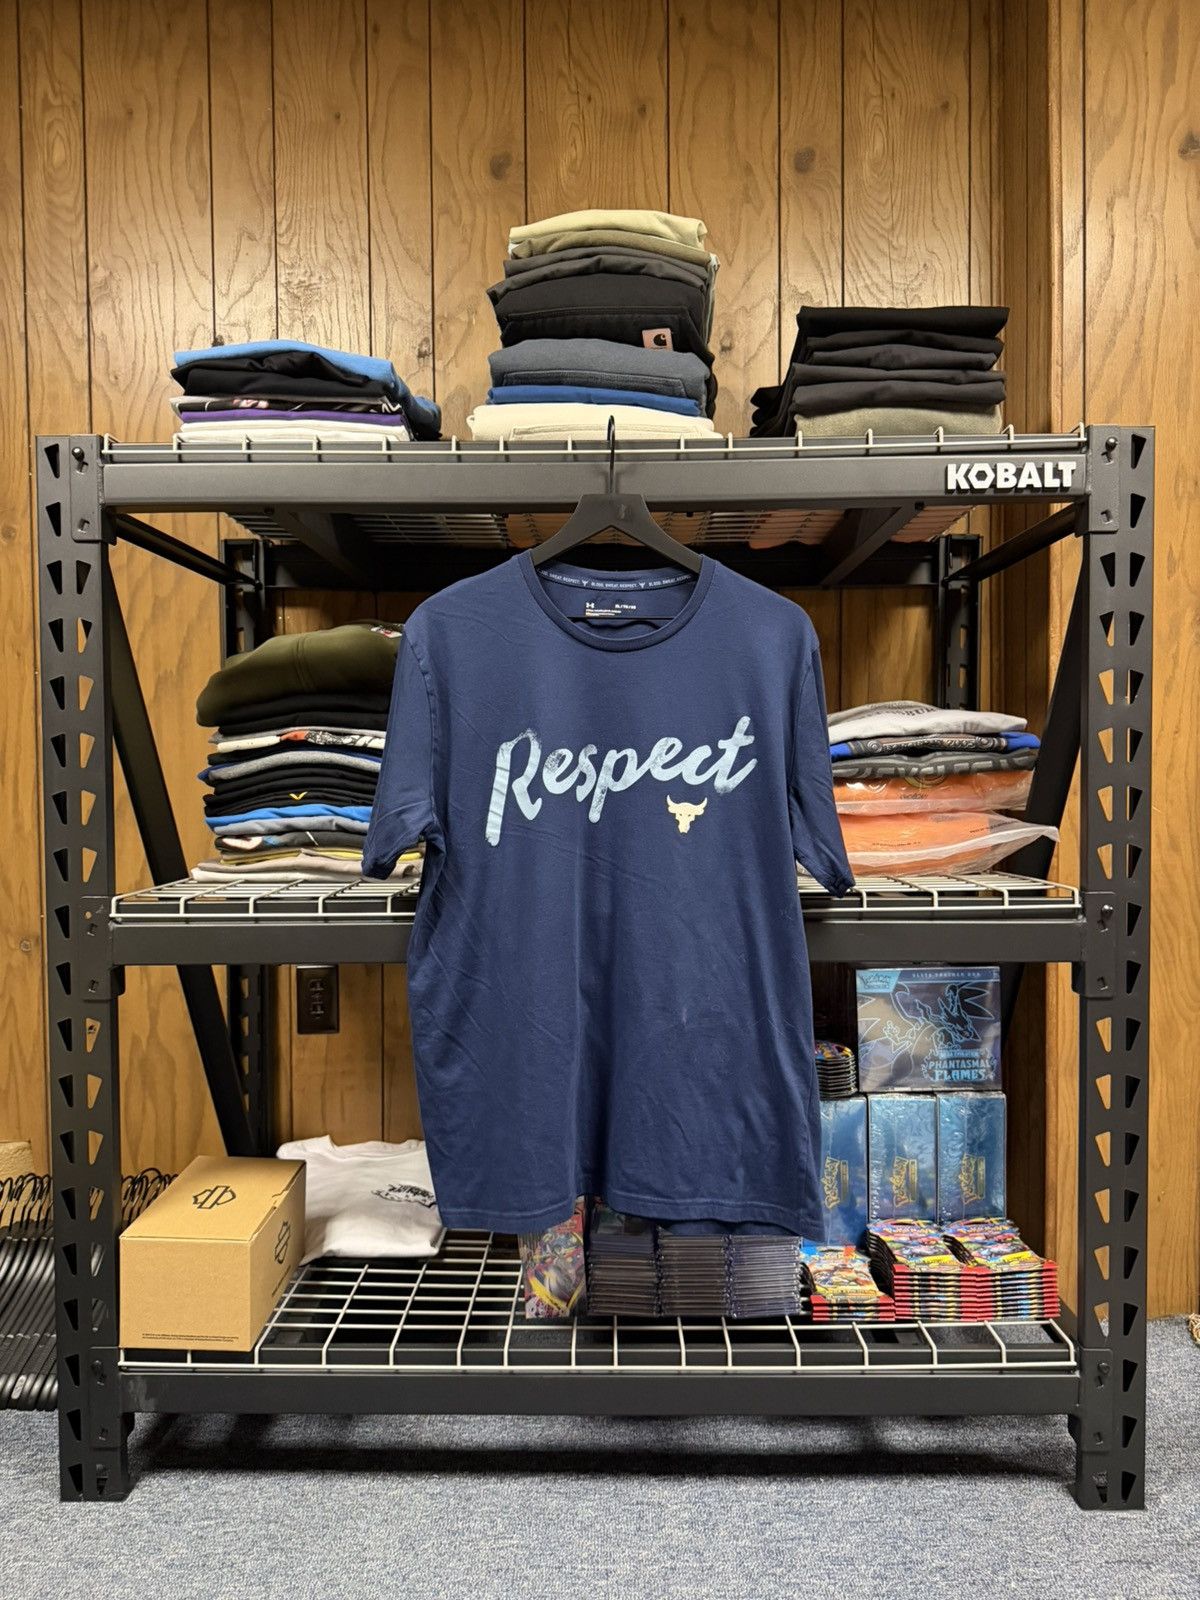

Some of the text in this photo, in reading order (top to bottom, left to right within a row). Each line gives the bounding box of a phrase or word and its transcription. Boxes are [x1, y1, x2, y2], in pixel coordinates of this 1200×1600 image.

[946, 461, 1077, 490] KOBALT
[485, 715, 758, 847] Respect
[928, 1059, 991, 1070] PHANTASMAL
[933, 1069, 987, 1082] FLAMES
